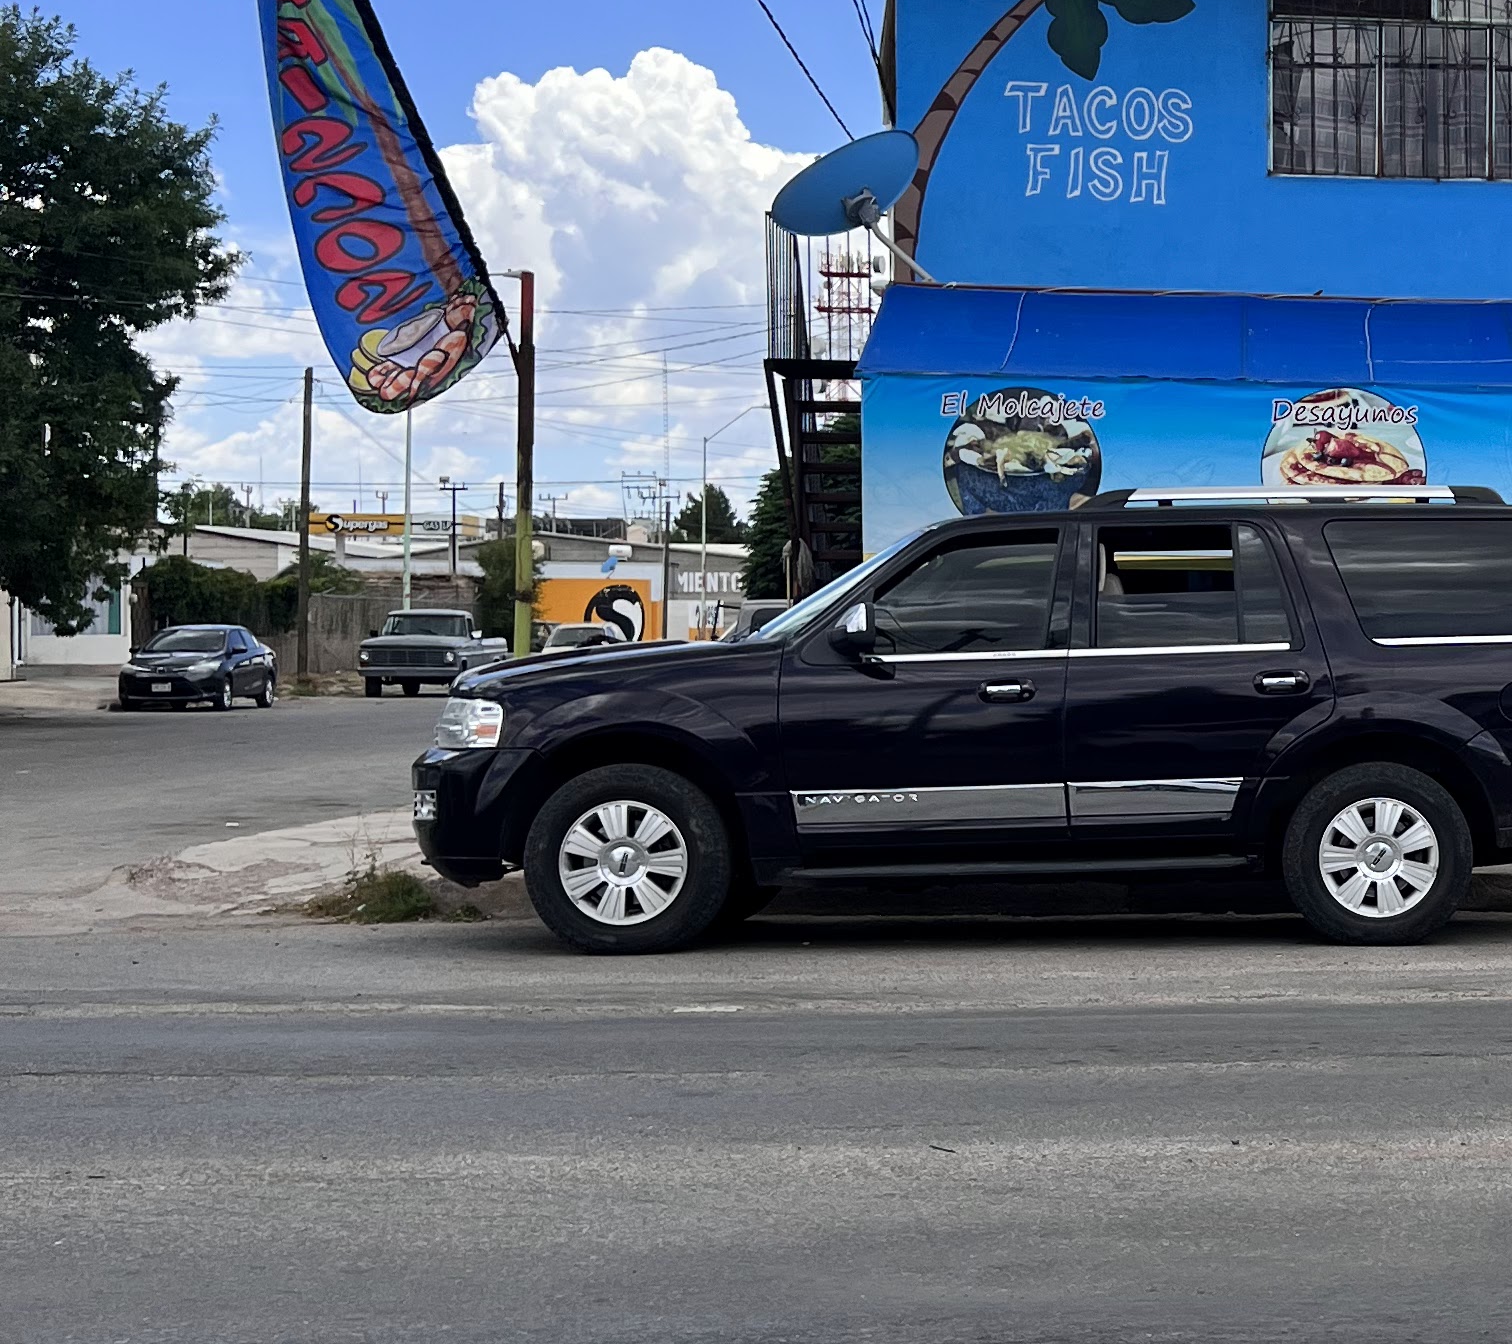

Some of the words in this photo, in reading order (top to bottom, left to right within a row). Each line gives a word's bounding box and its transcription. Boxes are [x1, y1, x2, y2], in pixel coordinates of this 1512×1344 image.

[1004, 81, 1194, 144] TACOS
[1025, 143, 1169, 205] FISH
[939, 390, 970, 418] El
[976, 392, 1106, 425] Molcajete
[1270, 398, 1419, 432] Desayunos
